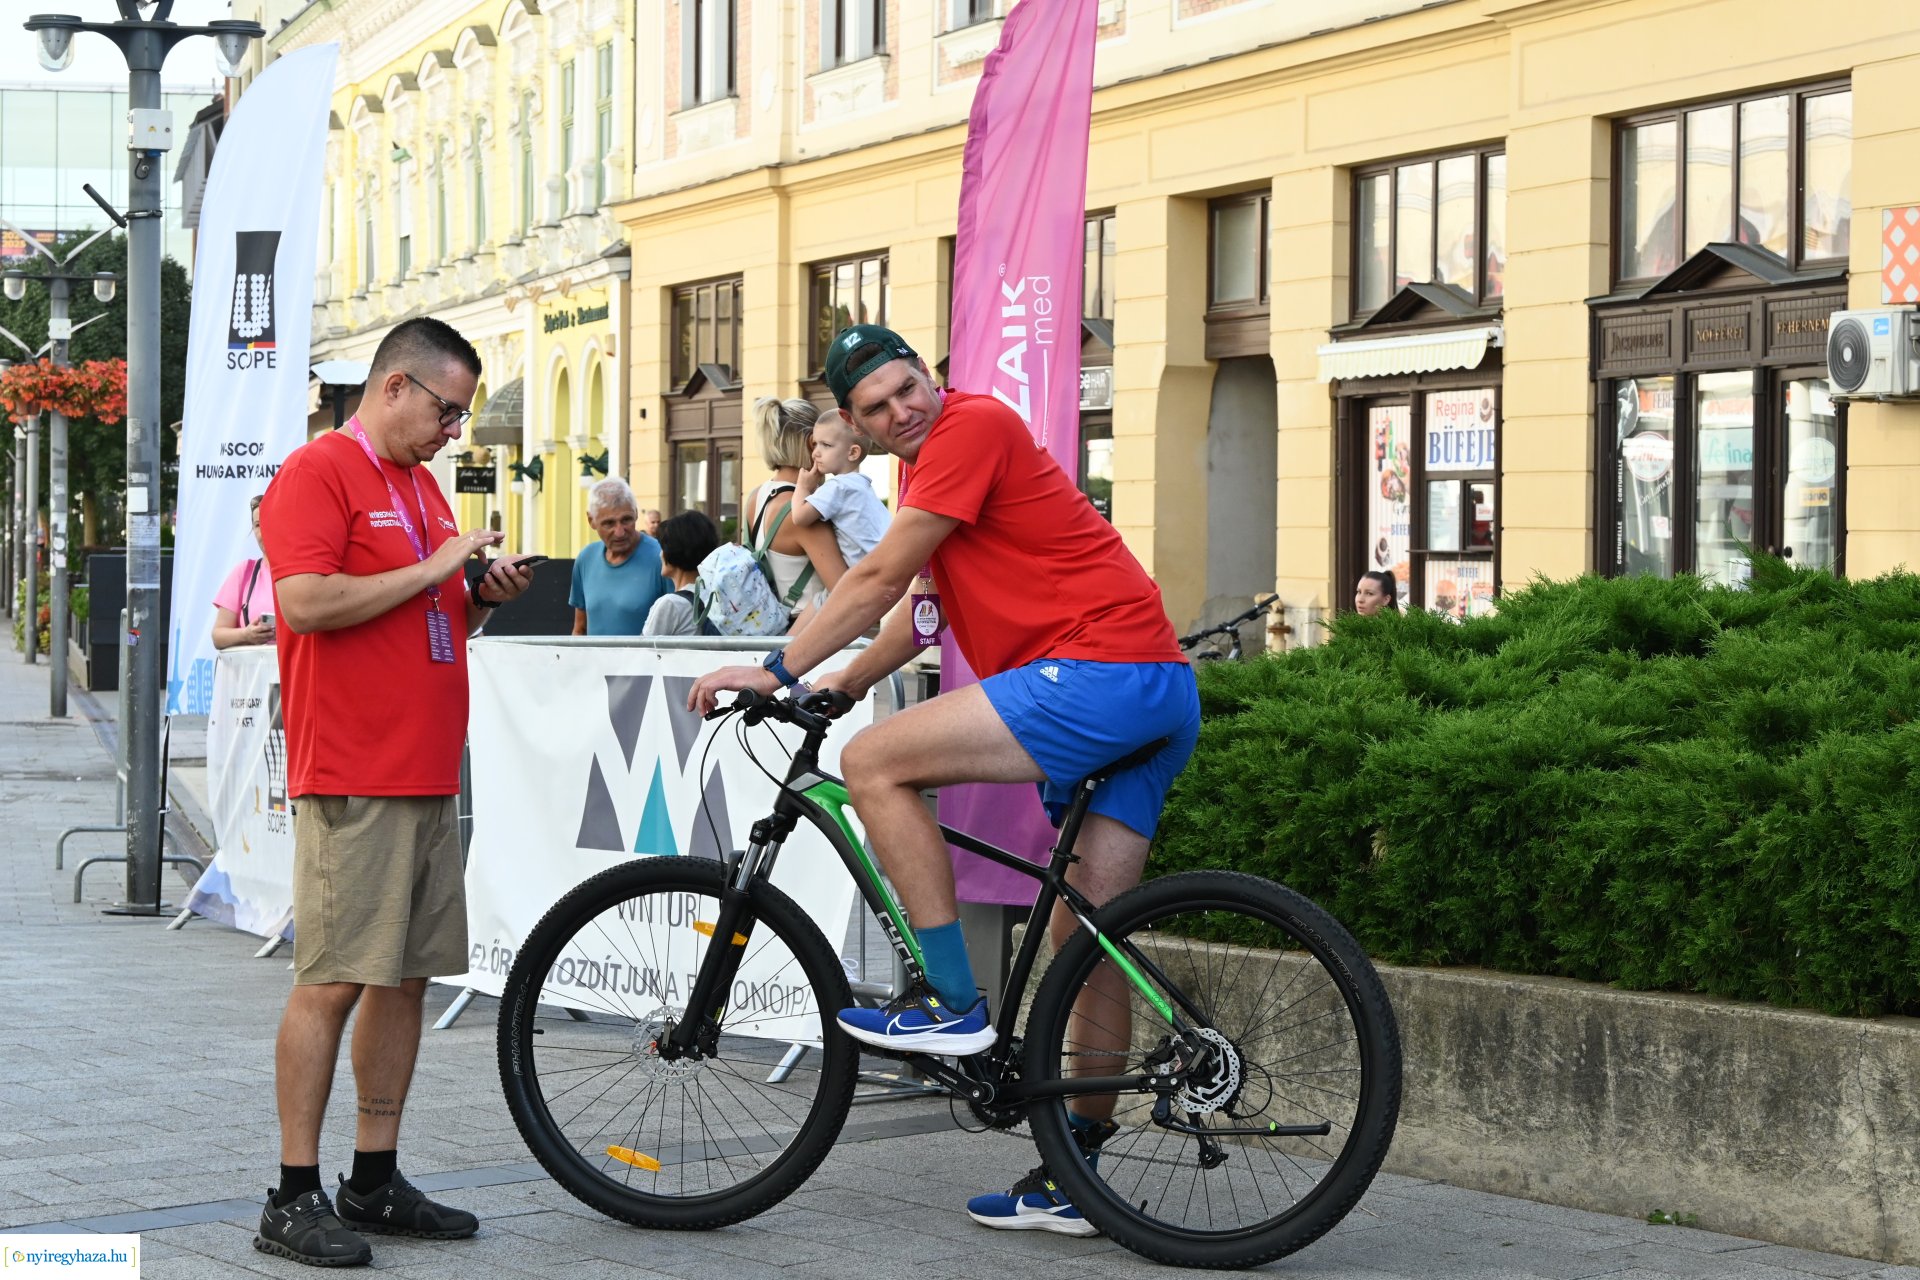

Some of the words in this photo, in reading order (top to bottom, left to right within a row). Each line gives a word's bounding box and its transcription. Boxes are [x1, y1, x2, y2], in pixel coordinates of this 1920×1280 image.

[1027, 275, 1053, 345] med
[843, 332, 862, 348] 12
[992, 276, 1031, 424] ZAIK
[1436, 399, 1475, 421] Regina
[1428, 423, 1494, 467] BÜFÉJE
[196, 464, 254, 479] HUNGARY
[919, 637, 936, 645] STAFF
[268, 813, 287, 835] SCOPE
[665, 971, 679, 1001] A
[511, 983, 528, 1076] PHANTOM
